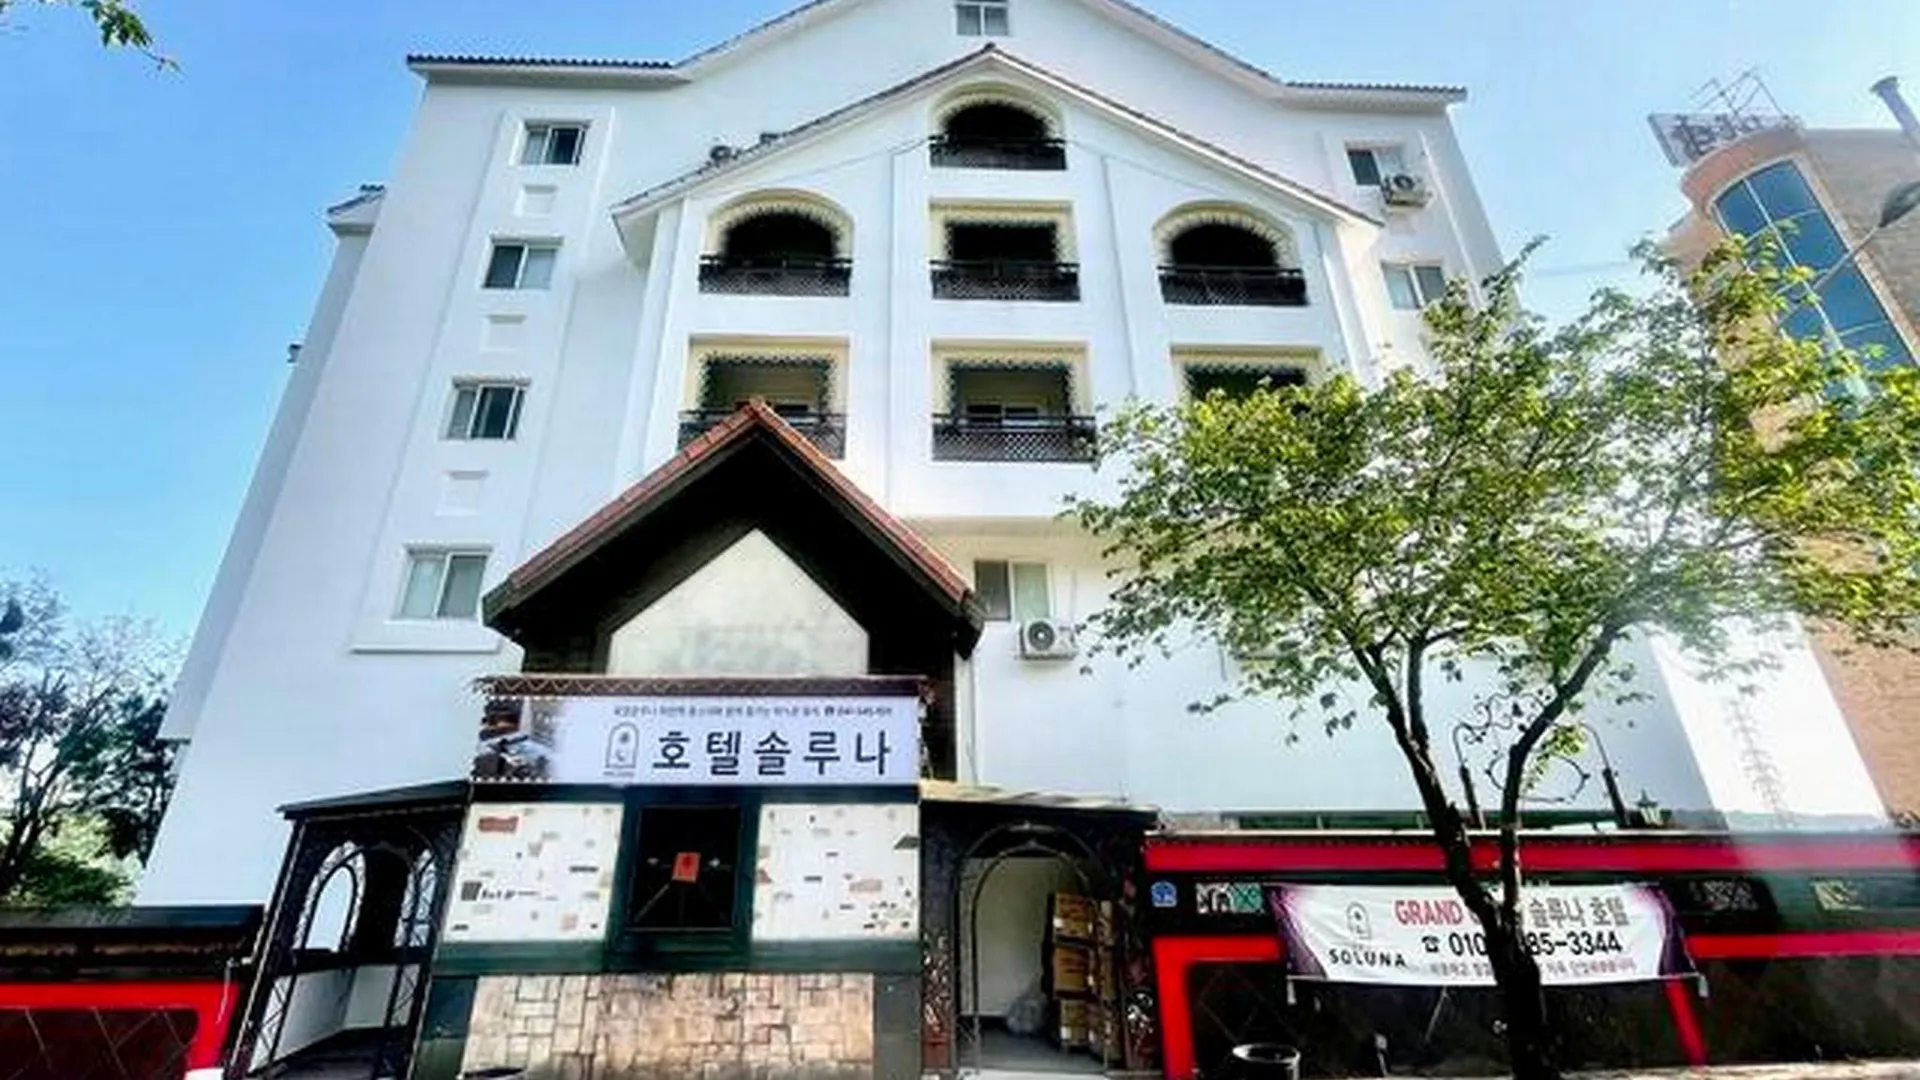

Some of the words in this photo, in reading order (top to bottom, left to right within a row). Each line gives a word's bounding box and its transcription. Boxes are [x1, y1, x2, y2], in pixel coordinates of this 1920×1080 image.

[653, 730, 891, 776] 호텔솔루나
[1395, 900, 1463, 925] GRAND
[1590, 897, 1630, 925] 호텔
[1329, 948, 1407, 967] SOLUNA
